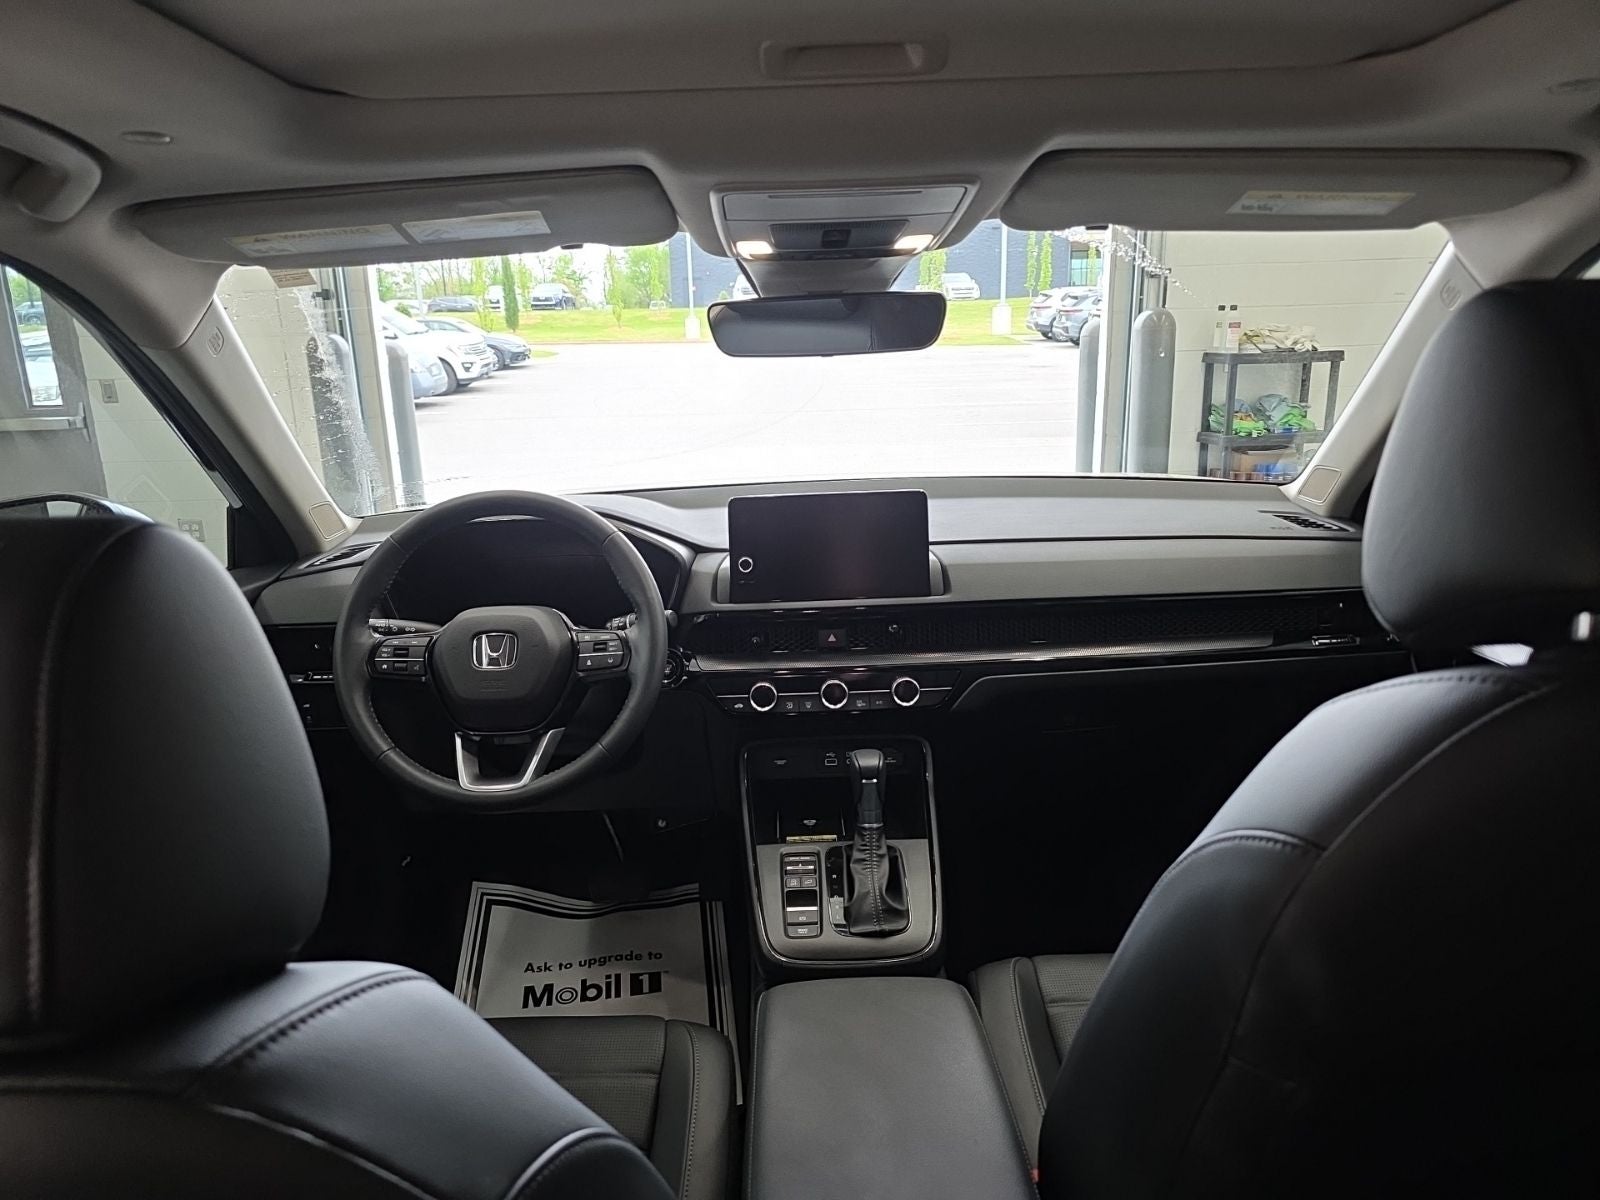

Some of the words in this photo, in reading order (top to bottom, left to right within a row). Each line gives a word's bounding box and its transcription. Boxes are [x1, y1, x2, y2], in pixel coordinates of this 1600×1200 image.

[524, 962, 552, 973] Ask
[558, 961, 573, 971] to
[578, 950, 643, 968] upgrade
[647, 951, 663, 961] to
[521, 973, 622, 1009] Mobil
